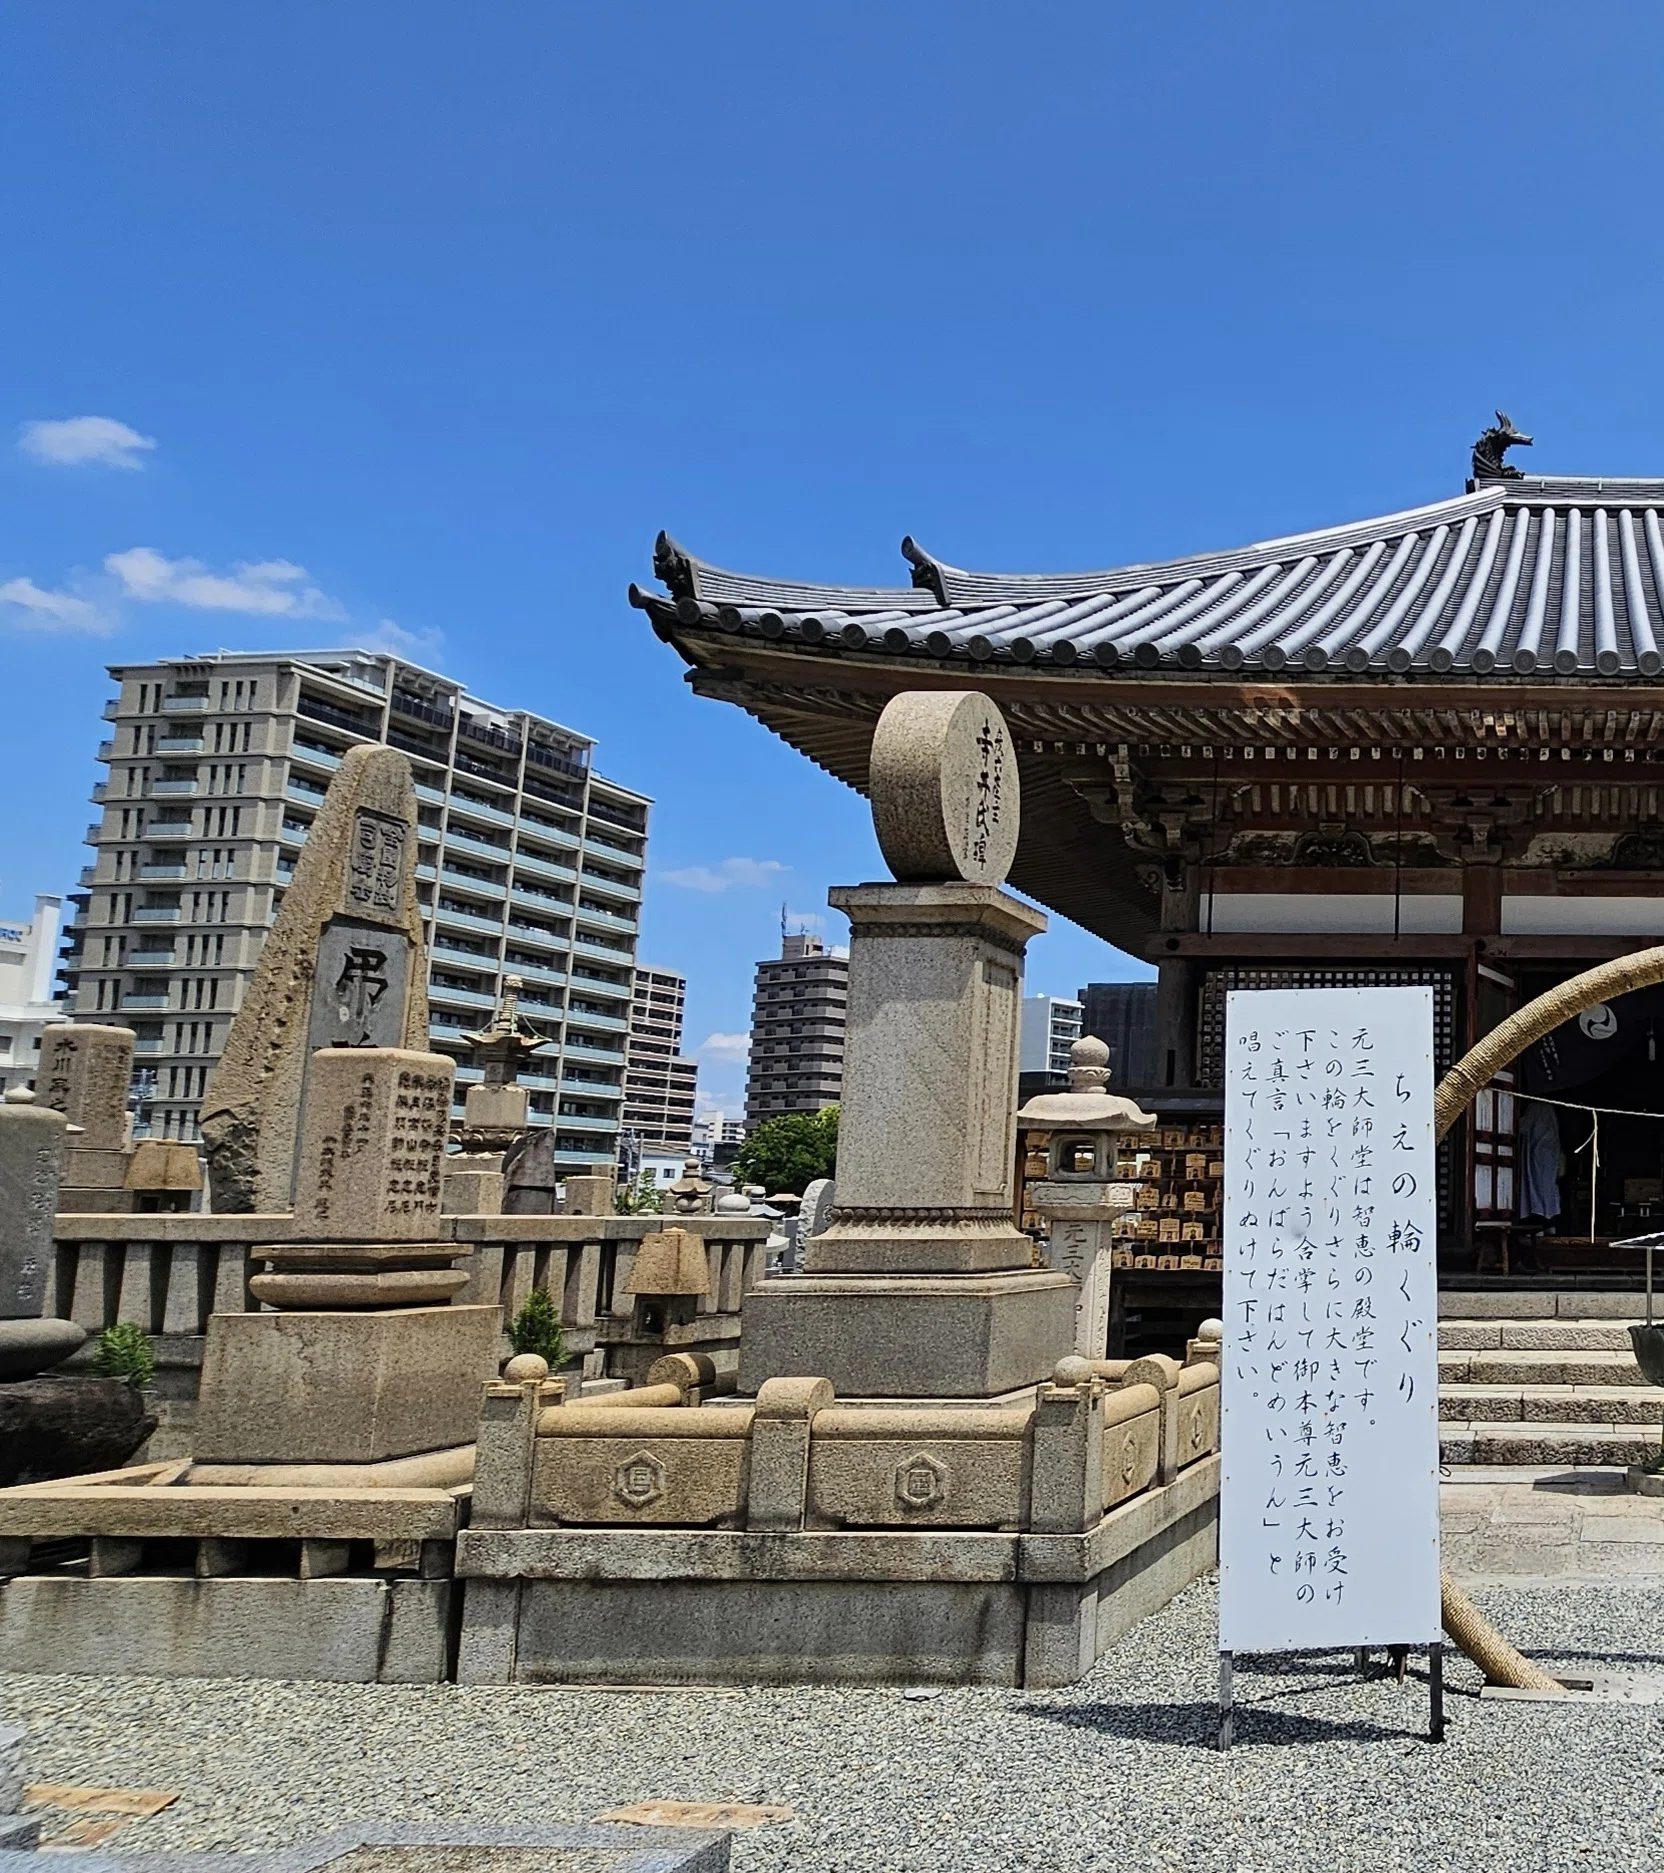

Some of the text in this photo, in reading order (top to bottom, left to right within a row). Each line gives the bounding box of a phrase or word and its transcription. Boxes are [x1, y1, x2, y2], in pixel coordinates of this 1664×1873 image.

[1236, 1030, 1262, 1399] 唱えてくぐりぬけて下さい。
[1262, 1028, 1292, 1575] ご真言「おんばらだはんどめいうん」と
[1293, 1028, 1319, 1605] 下さいますよう合掌して御本尊元三大師の
[1321, 1029, 1348, 1606] この輪をくぐりさらに大きな智恵をお受け
[1350, 1027, 1377, 1426] 元三大師堂は智恵の殿堂です。
[1386, 1073, 1424, 1404] ちえの輪くぐり
